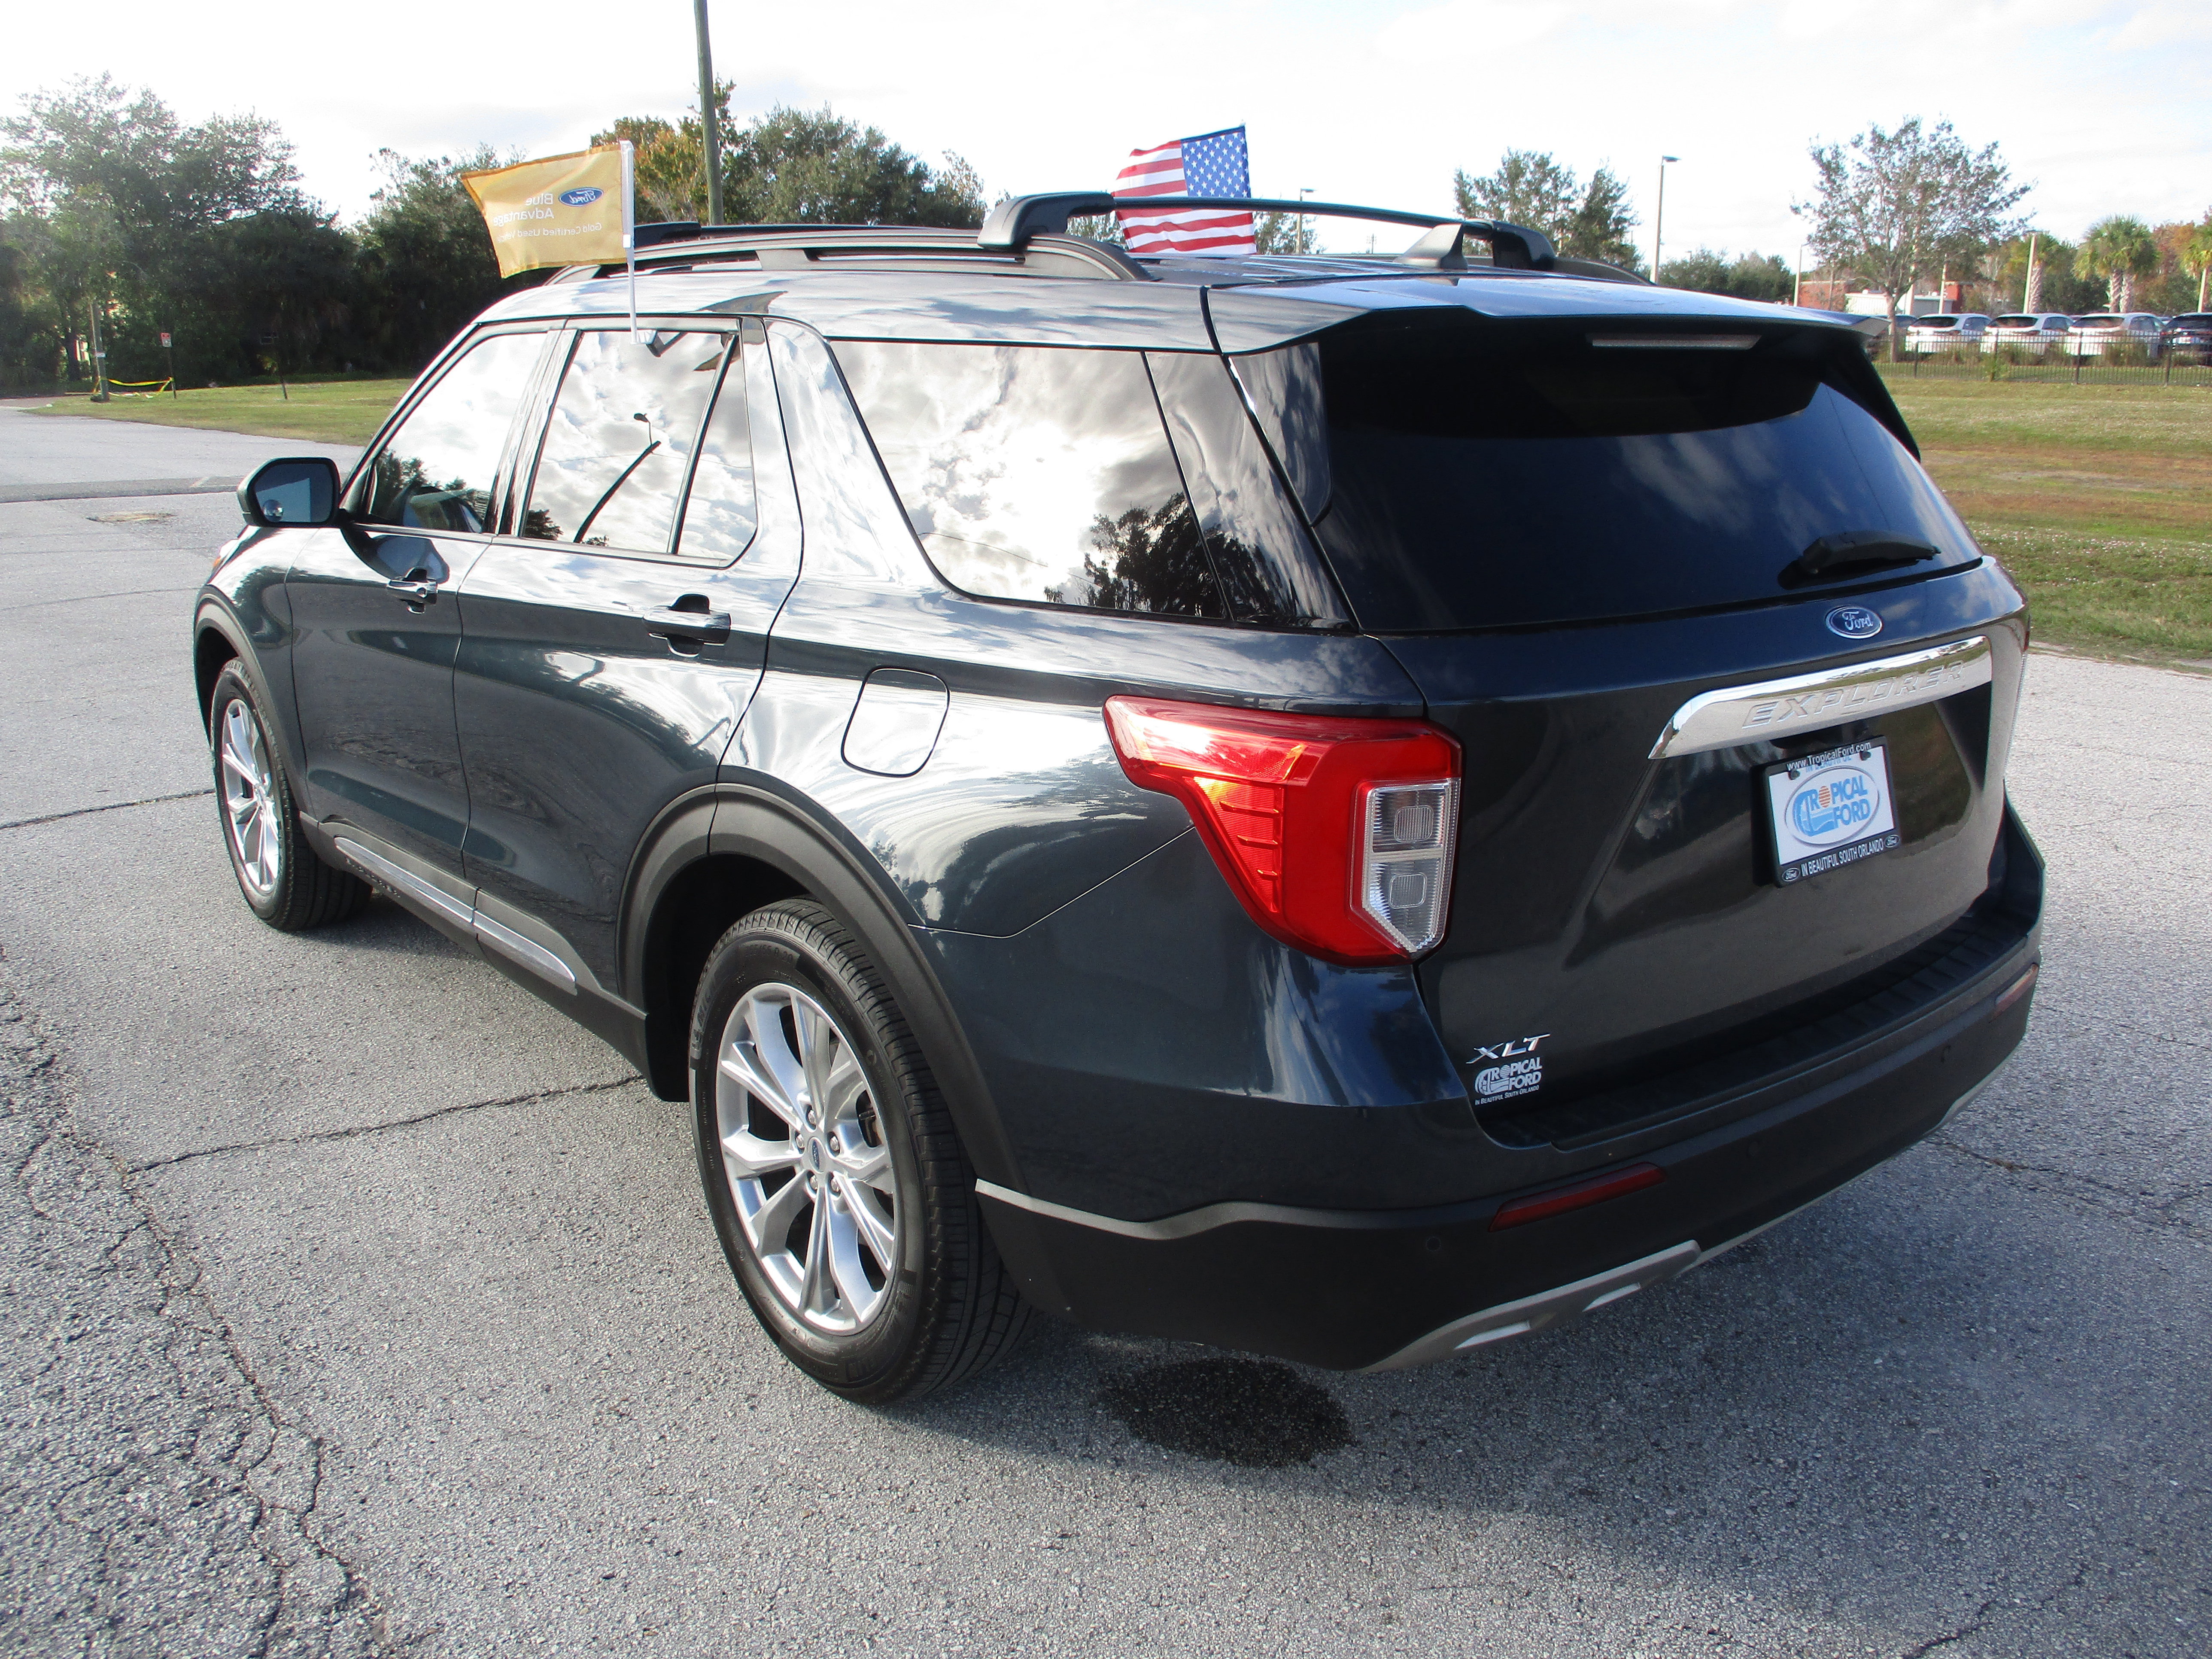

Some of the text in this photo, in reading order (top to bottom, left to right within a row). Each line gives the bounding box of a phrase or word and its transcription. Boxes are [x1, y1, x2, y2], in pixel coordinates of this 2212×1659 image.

[1842, 611, 1873, 631] Ford
[1741, 659, 1965, 729] EXPLORER
[1787, 742, 1871, 771] www.TropicalFord.com
[1833, 799, 1871, 829] FORD
[1801, 863, 1808, 877] IN
[1808, 853, 1839, 875] BEAUTIFUL
[1838, 847, 1858, 864] SOUTH
[1858, 838, 1884, 858] ORLANDO
[1465, 1033, 1551, 1063] XLT
[1508, 1071, 1542, 1091] FORD
